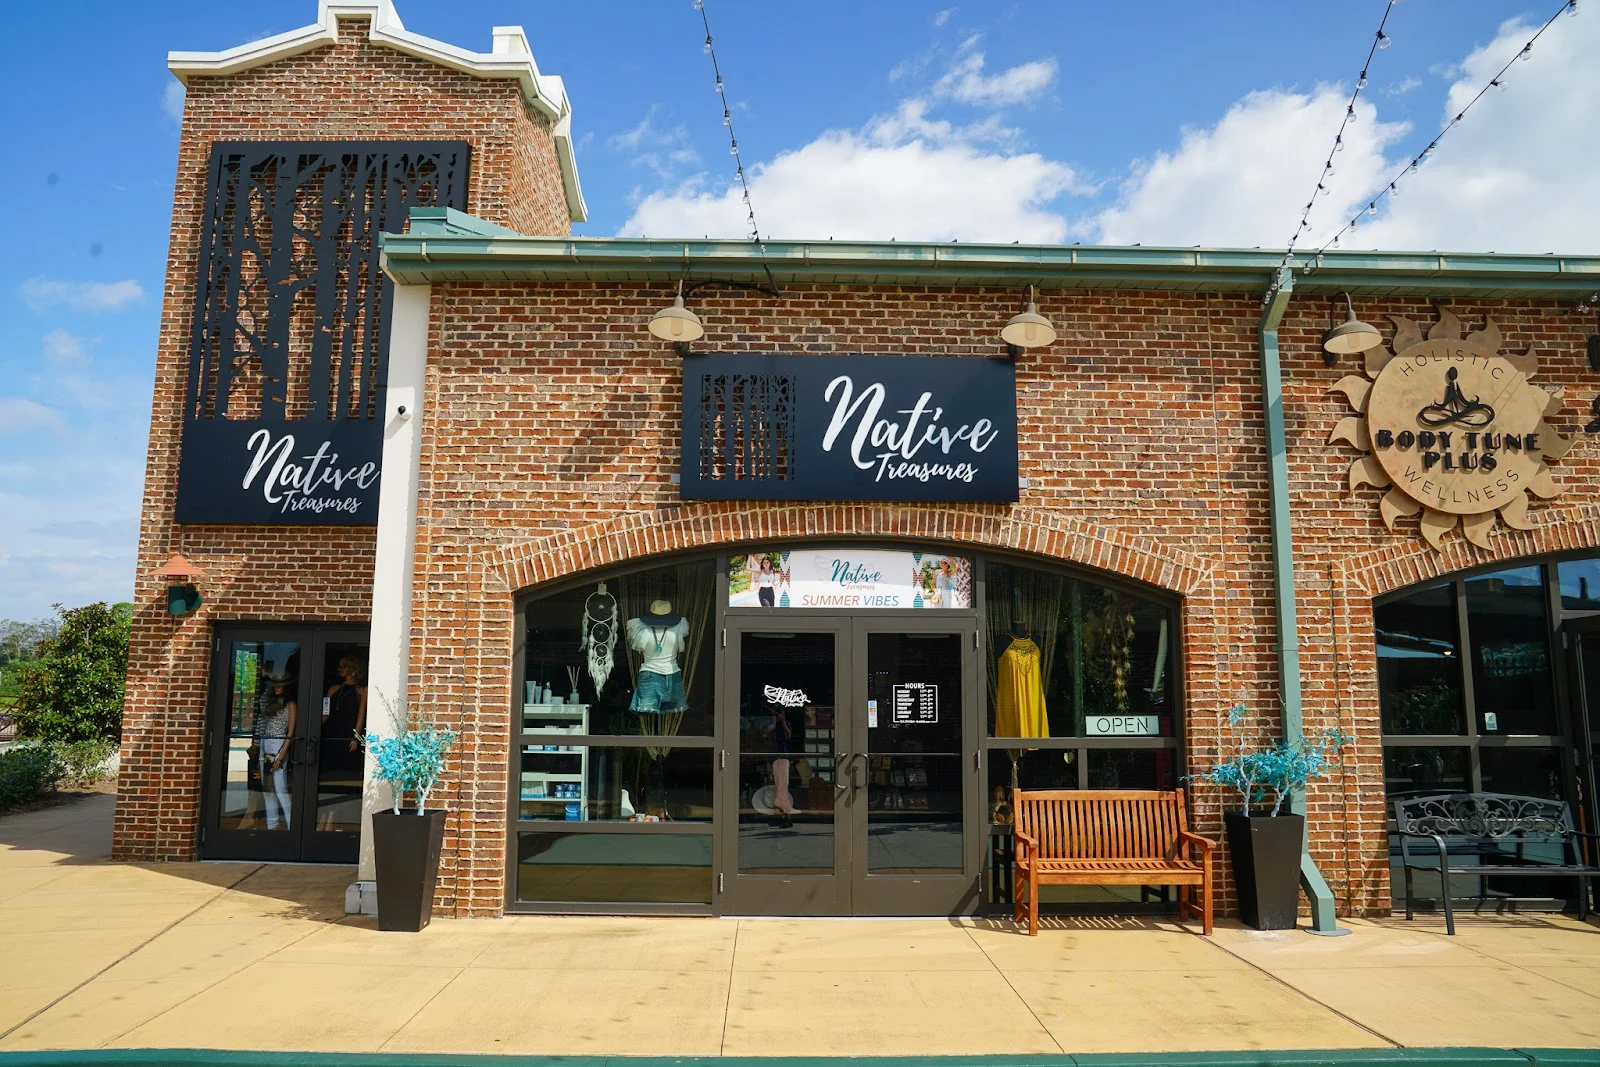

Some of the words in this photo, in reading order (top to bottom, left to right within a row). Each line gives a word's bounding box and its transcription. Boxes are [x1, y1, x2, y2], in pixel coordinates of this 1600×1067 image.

[1400, 349, 1504, 381] HOLISTIC
[822, 375, 999, 470] Native
[1377, 429, 1454, 450] BODY
[1466, 432, 1542, 451] TUNE
[242, 428, 381, 504] Native
[875, 452, 979, 483] Treasures
[1424, 451, 1498, 470] PLUS
[1404, 465, 1520, 504] WELLNESS
[280, 489, 362, 514] Treasures
[831, 558, 883, 587] Native
[802, 594, 860, 606] SUMMER
[863, 595, 900, 607] VIBES
[1096, 717, 1149, 733] OPEN
